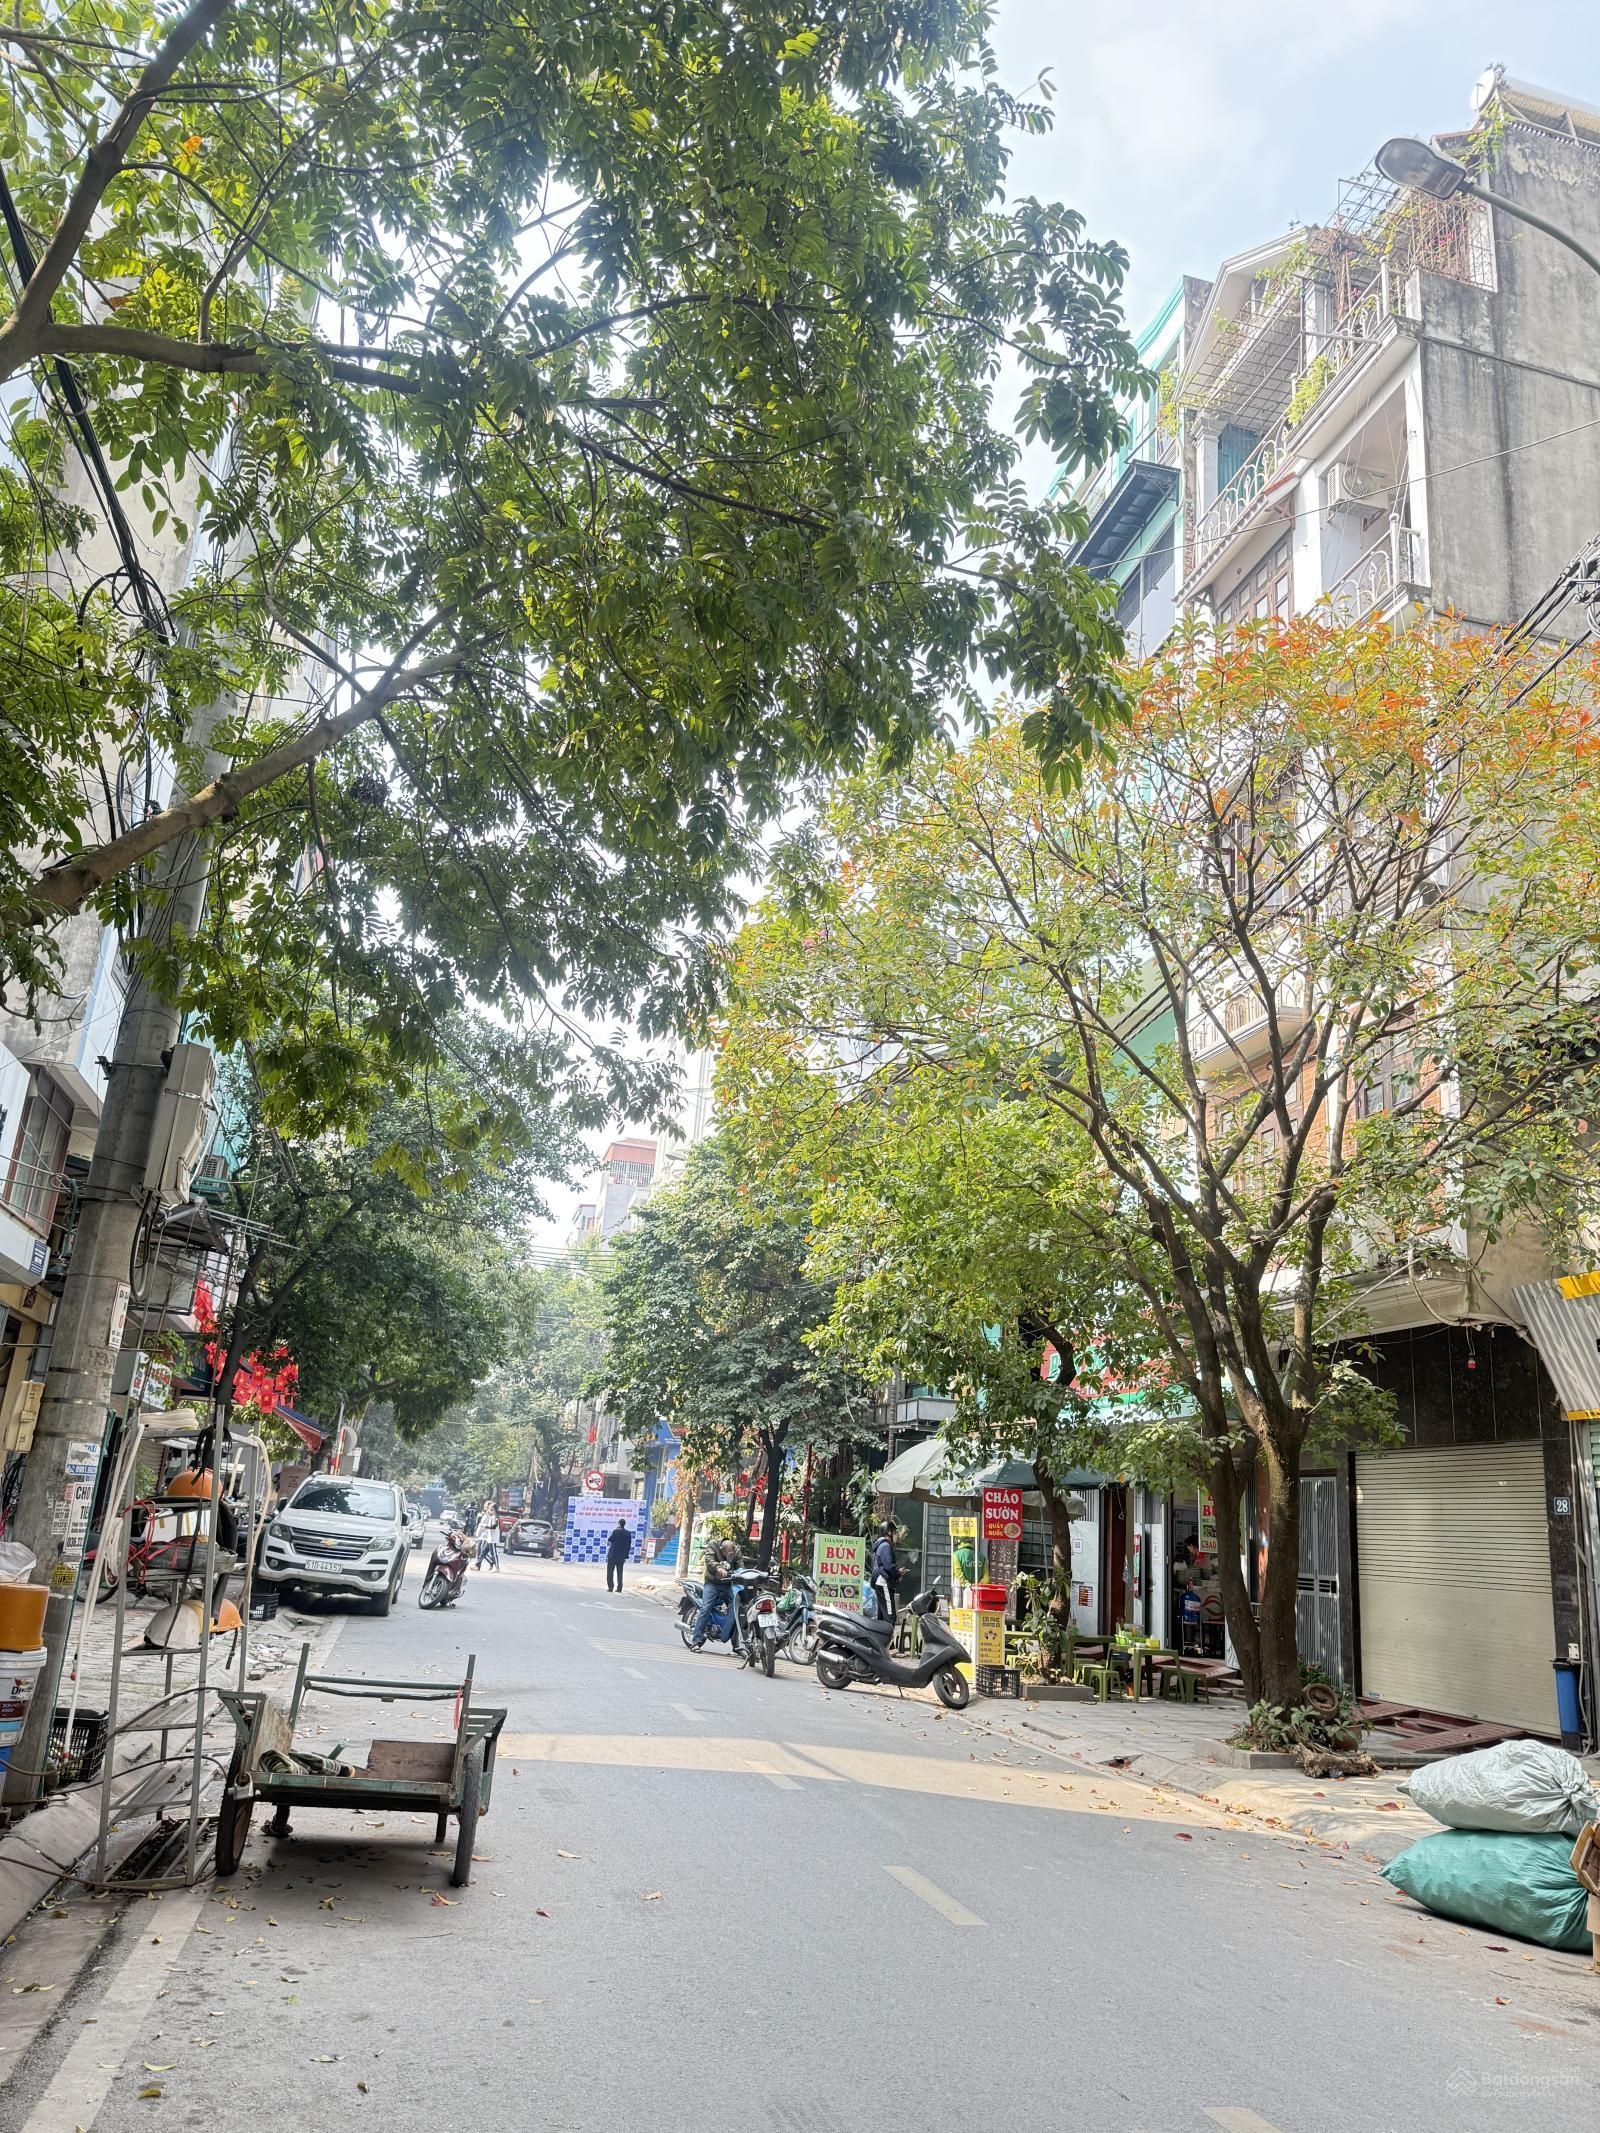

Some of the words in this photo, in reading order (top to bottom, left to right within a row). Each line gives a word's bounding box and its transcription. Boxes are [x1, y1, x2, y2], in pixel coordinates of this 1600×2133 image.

[985, 1490, 1019, 1504] CHÁO
[1556, 1499, 1568, 1512] 28
[985, 1506, 1018, 1520] SƯỜN
[826, 1544, 856, 1560] BÚN
[820, 1562, 861, 1577] BUNG
